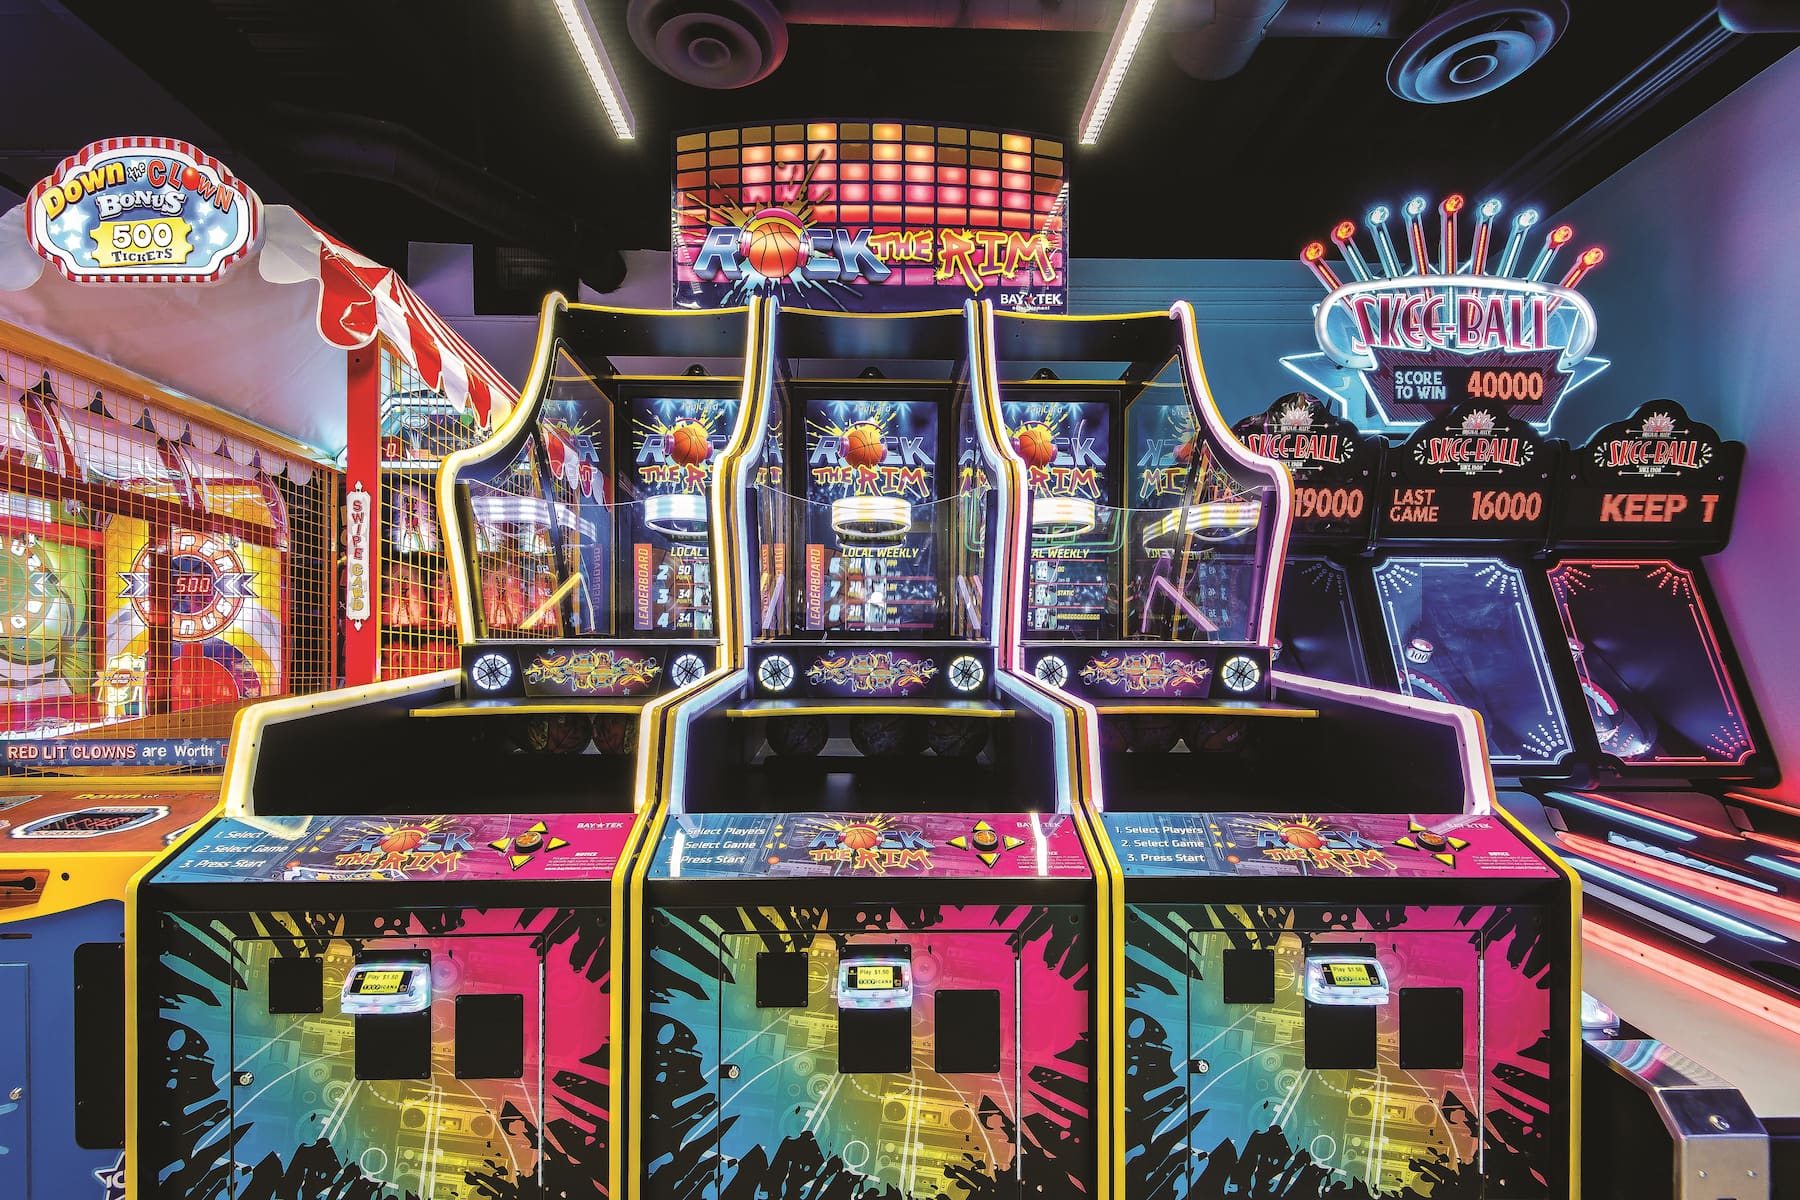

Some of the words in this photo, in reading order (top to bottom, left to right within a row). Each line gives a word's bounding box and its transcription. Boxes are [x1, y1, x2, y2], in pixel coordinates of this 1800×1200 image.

[128, 162, 146, 180] the
[147, 159, 234, 213] CLOWN
[96, 190, 186, 220] BONUS
[112, 223, 173, 249] 500
[112, 249, 173, 263] TICKETS
[868, 230, 935, 262] THE
[937, 228, 1056, 292] RIM
[1001, 294, 1025, 305] BAY
[1352, 293, 1549, 354] SKEE-BALL
[1395, 371, 1443, 386] SCORE
[1467, 370, 1543, 400] 40000
[1396, 386, 1414, 400] TO
[1416, 386, 1446, 400] WIN
[1248, 434, 1342, 464] SKEE-BALL
[1427, 437, 1521, 467] SKEE-BALL
[1607, 440, 1699, 469] SKEE-BALL
[638, 466, 681, 484] THE
[812, 466, 852, 485] THE
[856, 464, 931, 498] RIM
[1029, 465, 1100, 499] RIM
[1295, 487, 1364, 518] 19000
[1393, 489, 1435, 505] LAST
[1472, 490, 1542, 521] 16000
[1600, 494, 1688, 522] KEEP
[1701, 495, 1719, 522] T
[1390, 506, 1439, 522] GAME
[351, 500, 364, 560] SWIPE
[671, 547, 703, 556] LOCAL
[842, 548, 874, 557] LOCAL
[877, 548, 919, 558] WEEKLY
[1047, 549, 1090, 559] WEEKLY
[657, 565, 669, 580] 2
[176, 577, 210, 593] 500
[351, 563, 364, 612] CARD
[638, 548, 649, 625] LEADERBOARD
[811, 548, 821, 626] LEADERBOARD
[830, 580, 841, 598] 7
[657, 589, 669, 604] 3
[678, 589, 690, 598] 34
[657, 612, 669, 628] 4
[678, 612, 691, 623] 34
[1409, 651, 1428, 661] 100
[8, 746, 39, 760] RED
[43, 746, 67, 760] LIT
[72, 746, 136, 759] CLOWNS
[142, 747, 167, 757] are
[175, 745, 213, 757] Worth
[226, 831, 264, 839] Select
[686, 827, 723, 835] Select
[726, 828, 765, 836] Players
[1125, 826, 1159, 834] Select
[1163, 826, 1203, 835] Players
[210, 845, 249, 853] Select
[251, 845, 288, 853] Game
[685, 841, 720, 849] Select
[722, 841, 756, 849] Game
[1134, 839, 1169, 847] Select
[1172, 840, 1204, 848] Game
[194, 860, 232, 868] Press
[232, 859, 266, 868] Start
[335, 852, 379, 867] THE
[377, 851, 461, 872] RIM
[681, 855, 714, 864] Press
[716, 855, 745, 864] Start
[809, 849, 851, 861] THE
[855, 849, 934, 874] RIM
[1141, 854, 1173, 862] Press
[1176, 854, 1205, 862] Start
[1263, 849, 1309, 861] THE
[1308, 850, 1398, 875] RIM
